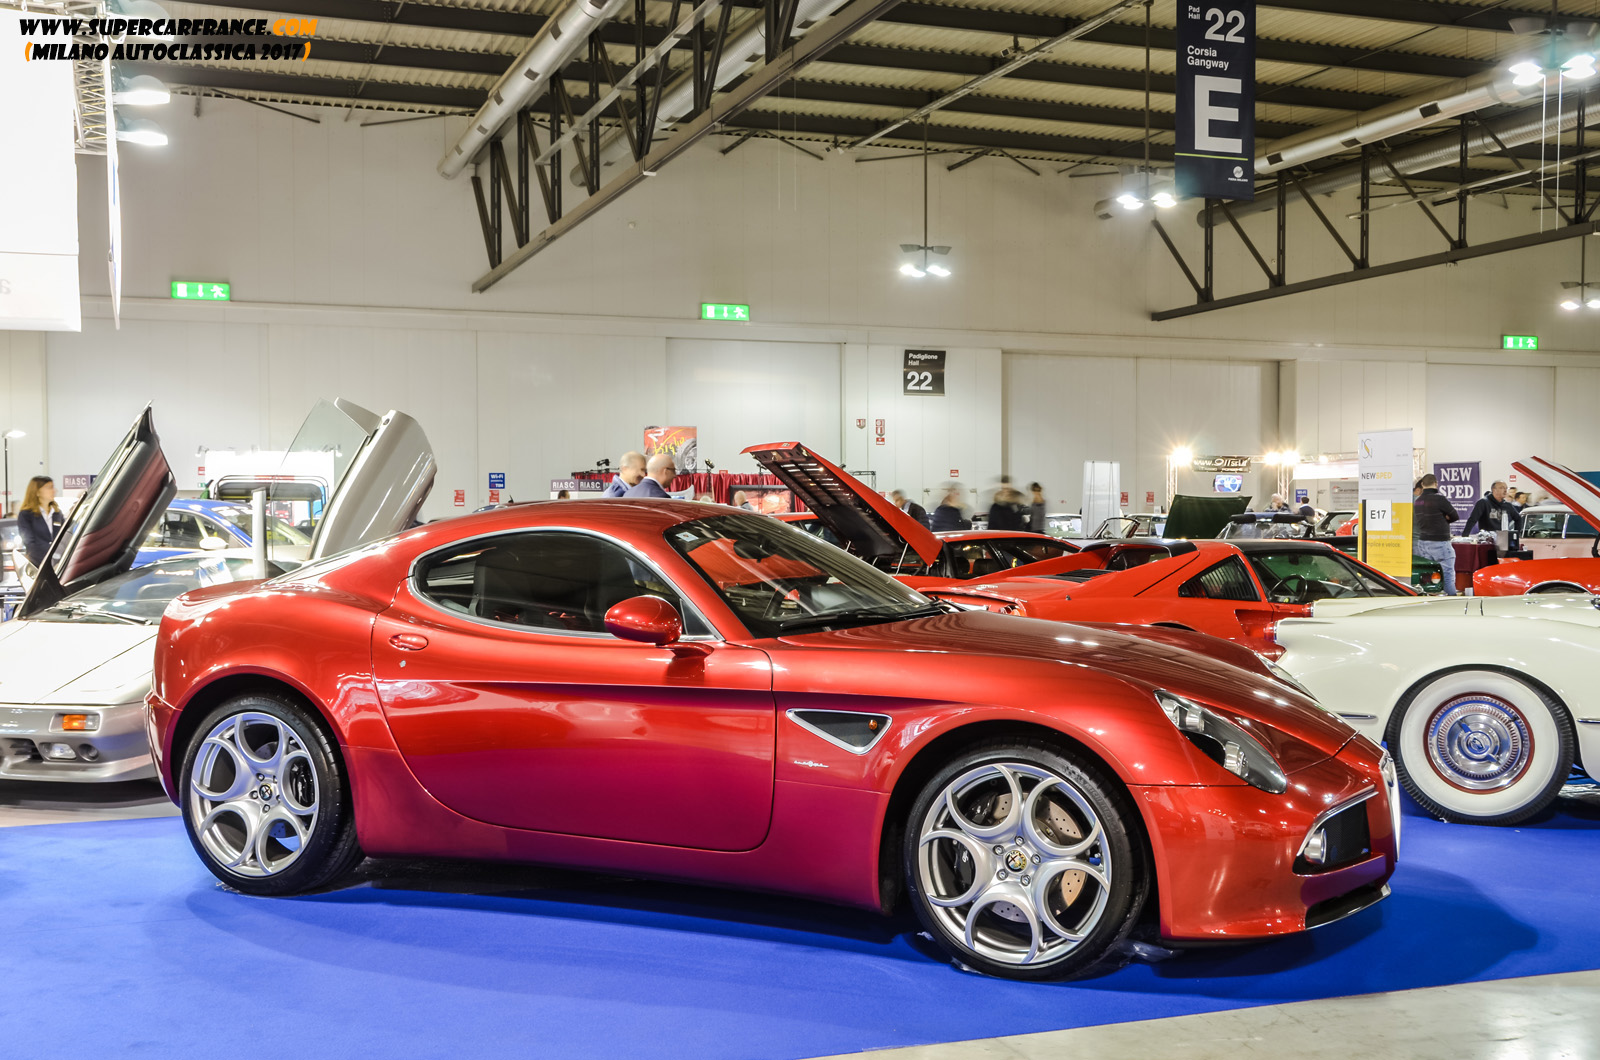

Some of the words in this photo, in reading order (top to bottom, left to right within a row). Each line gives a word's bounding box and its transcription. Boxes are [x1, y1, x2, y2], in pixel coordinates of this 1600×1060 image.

[1188, 5, 1200, 13] Pad
[1188, 12, 1201, 20] Hall
[1205, 7, 1246, 44] 22
[1187, 45, 1217, 57] Corsia
[1187, 56, 1229, 71] Gangway
[1194, 74, 1242, 154] E
[907, 371, 933, 390] 22
[1440, 467, 1472, 482] NEW
[64, 476, 87, 486] RIASC
[552, 481, 575, 489] RIASC
[579, 481, 601, 489] RIASC
[1439, 484, 1474, 499] SPED
[1370, 509, 1387, 520] E17
